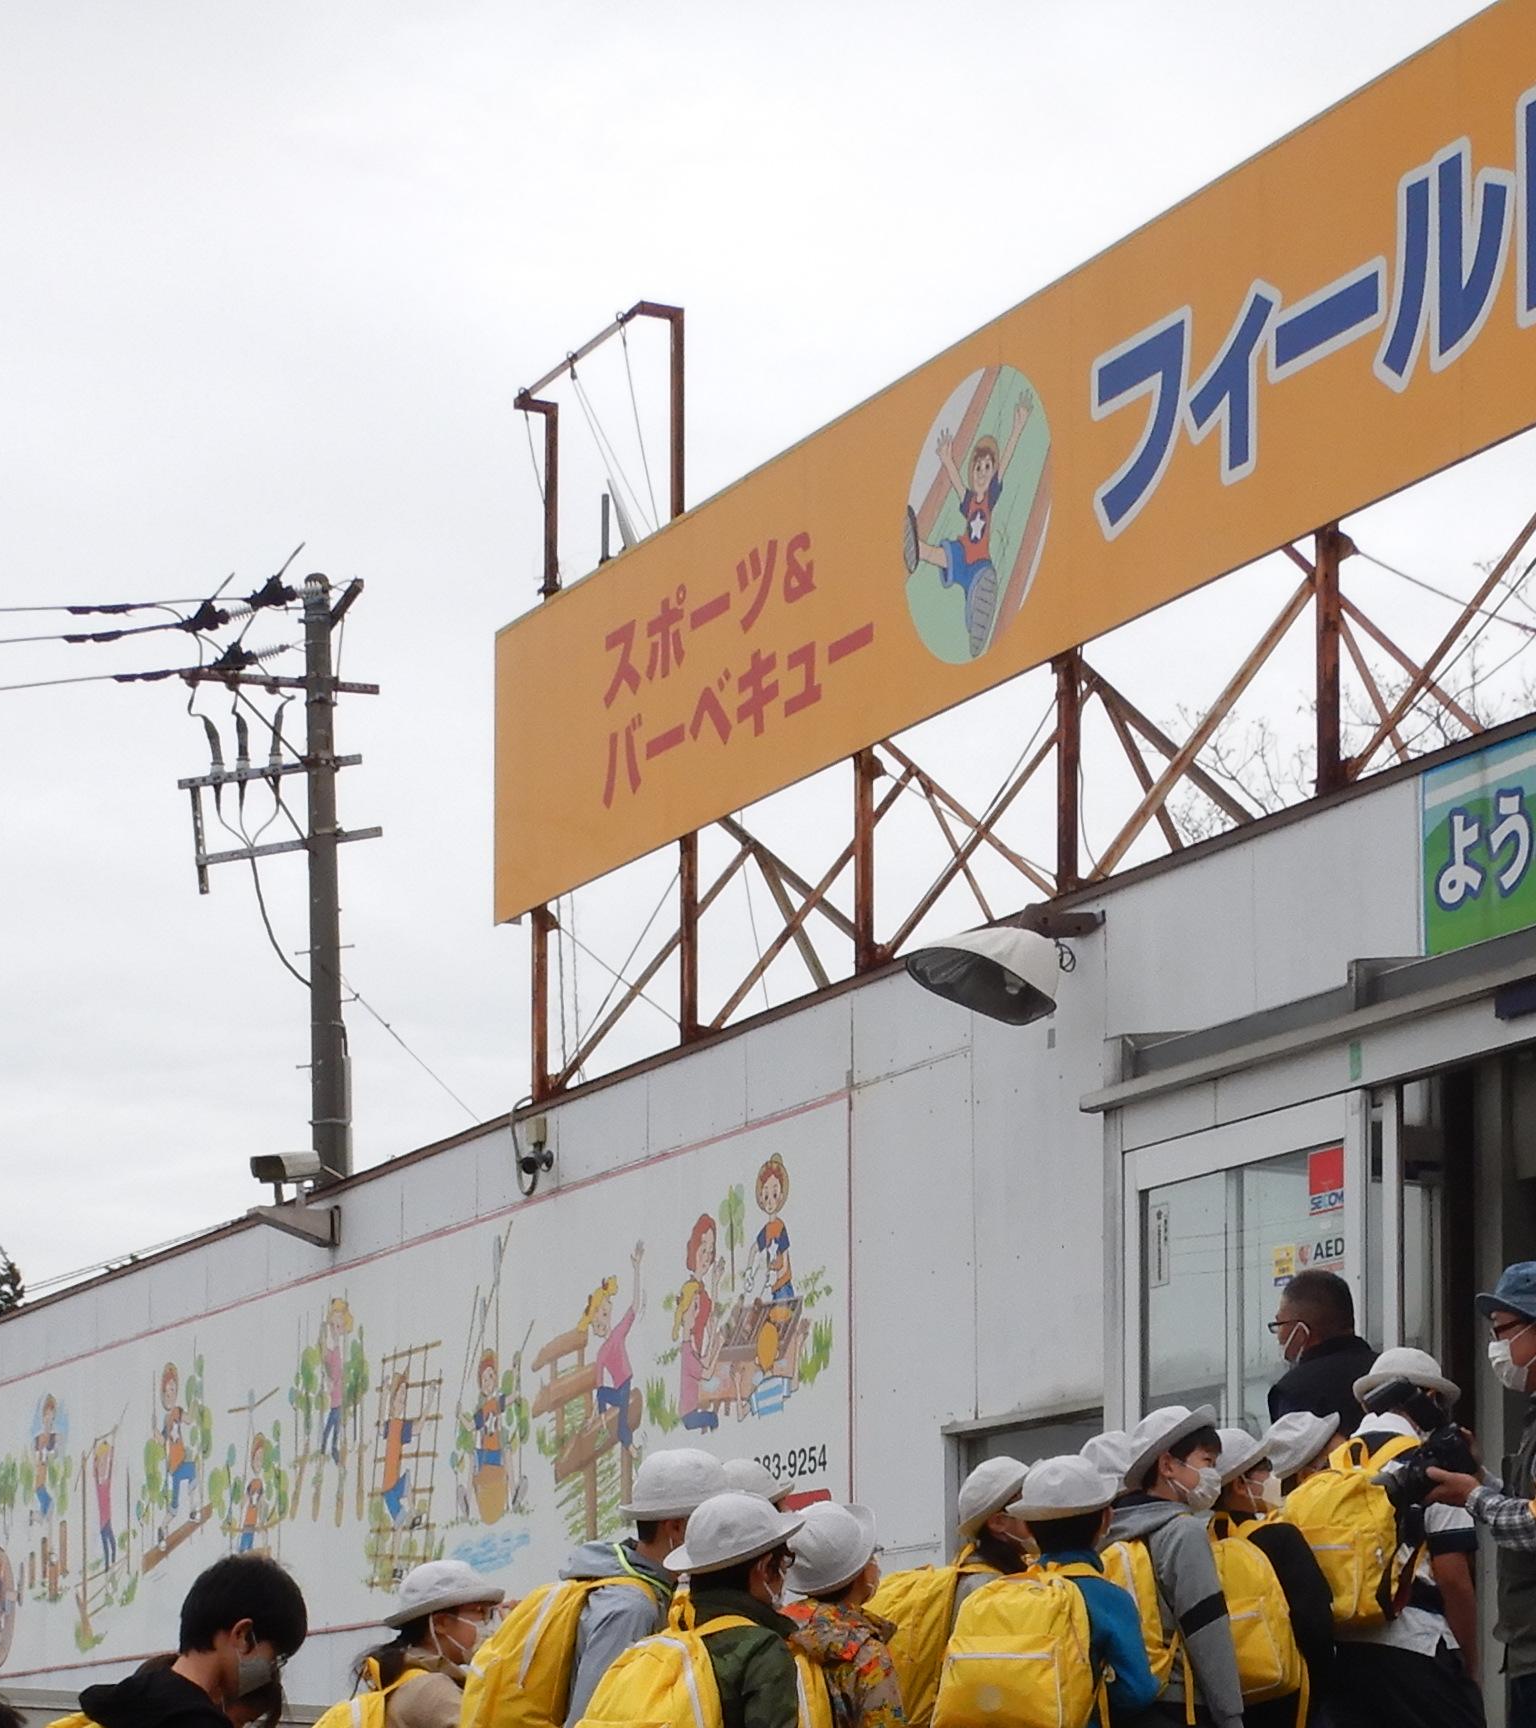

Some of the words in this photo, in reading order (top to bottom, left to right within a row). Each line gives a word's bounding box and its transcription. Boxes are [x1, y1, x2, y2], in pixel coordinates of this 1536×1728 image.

[603, 531, 816, 710] スポーツ&
[602, 621, 874, 810] バーベキュー
[1314, 1237, 1344, 1260] AED
[754, 1443, 827, 1480] 83-9254
